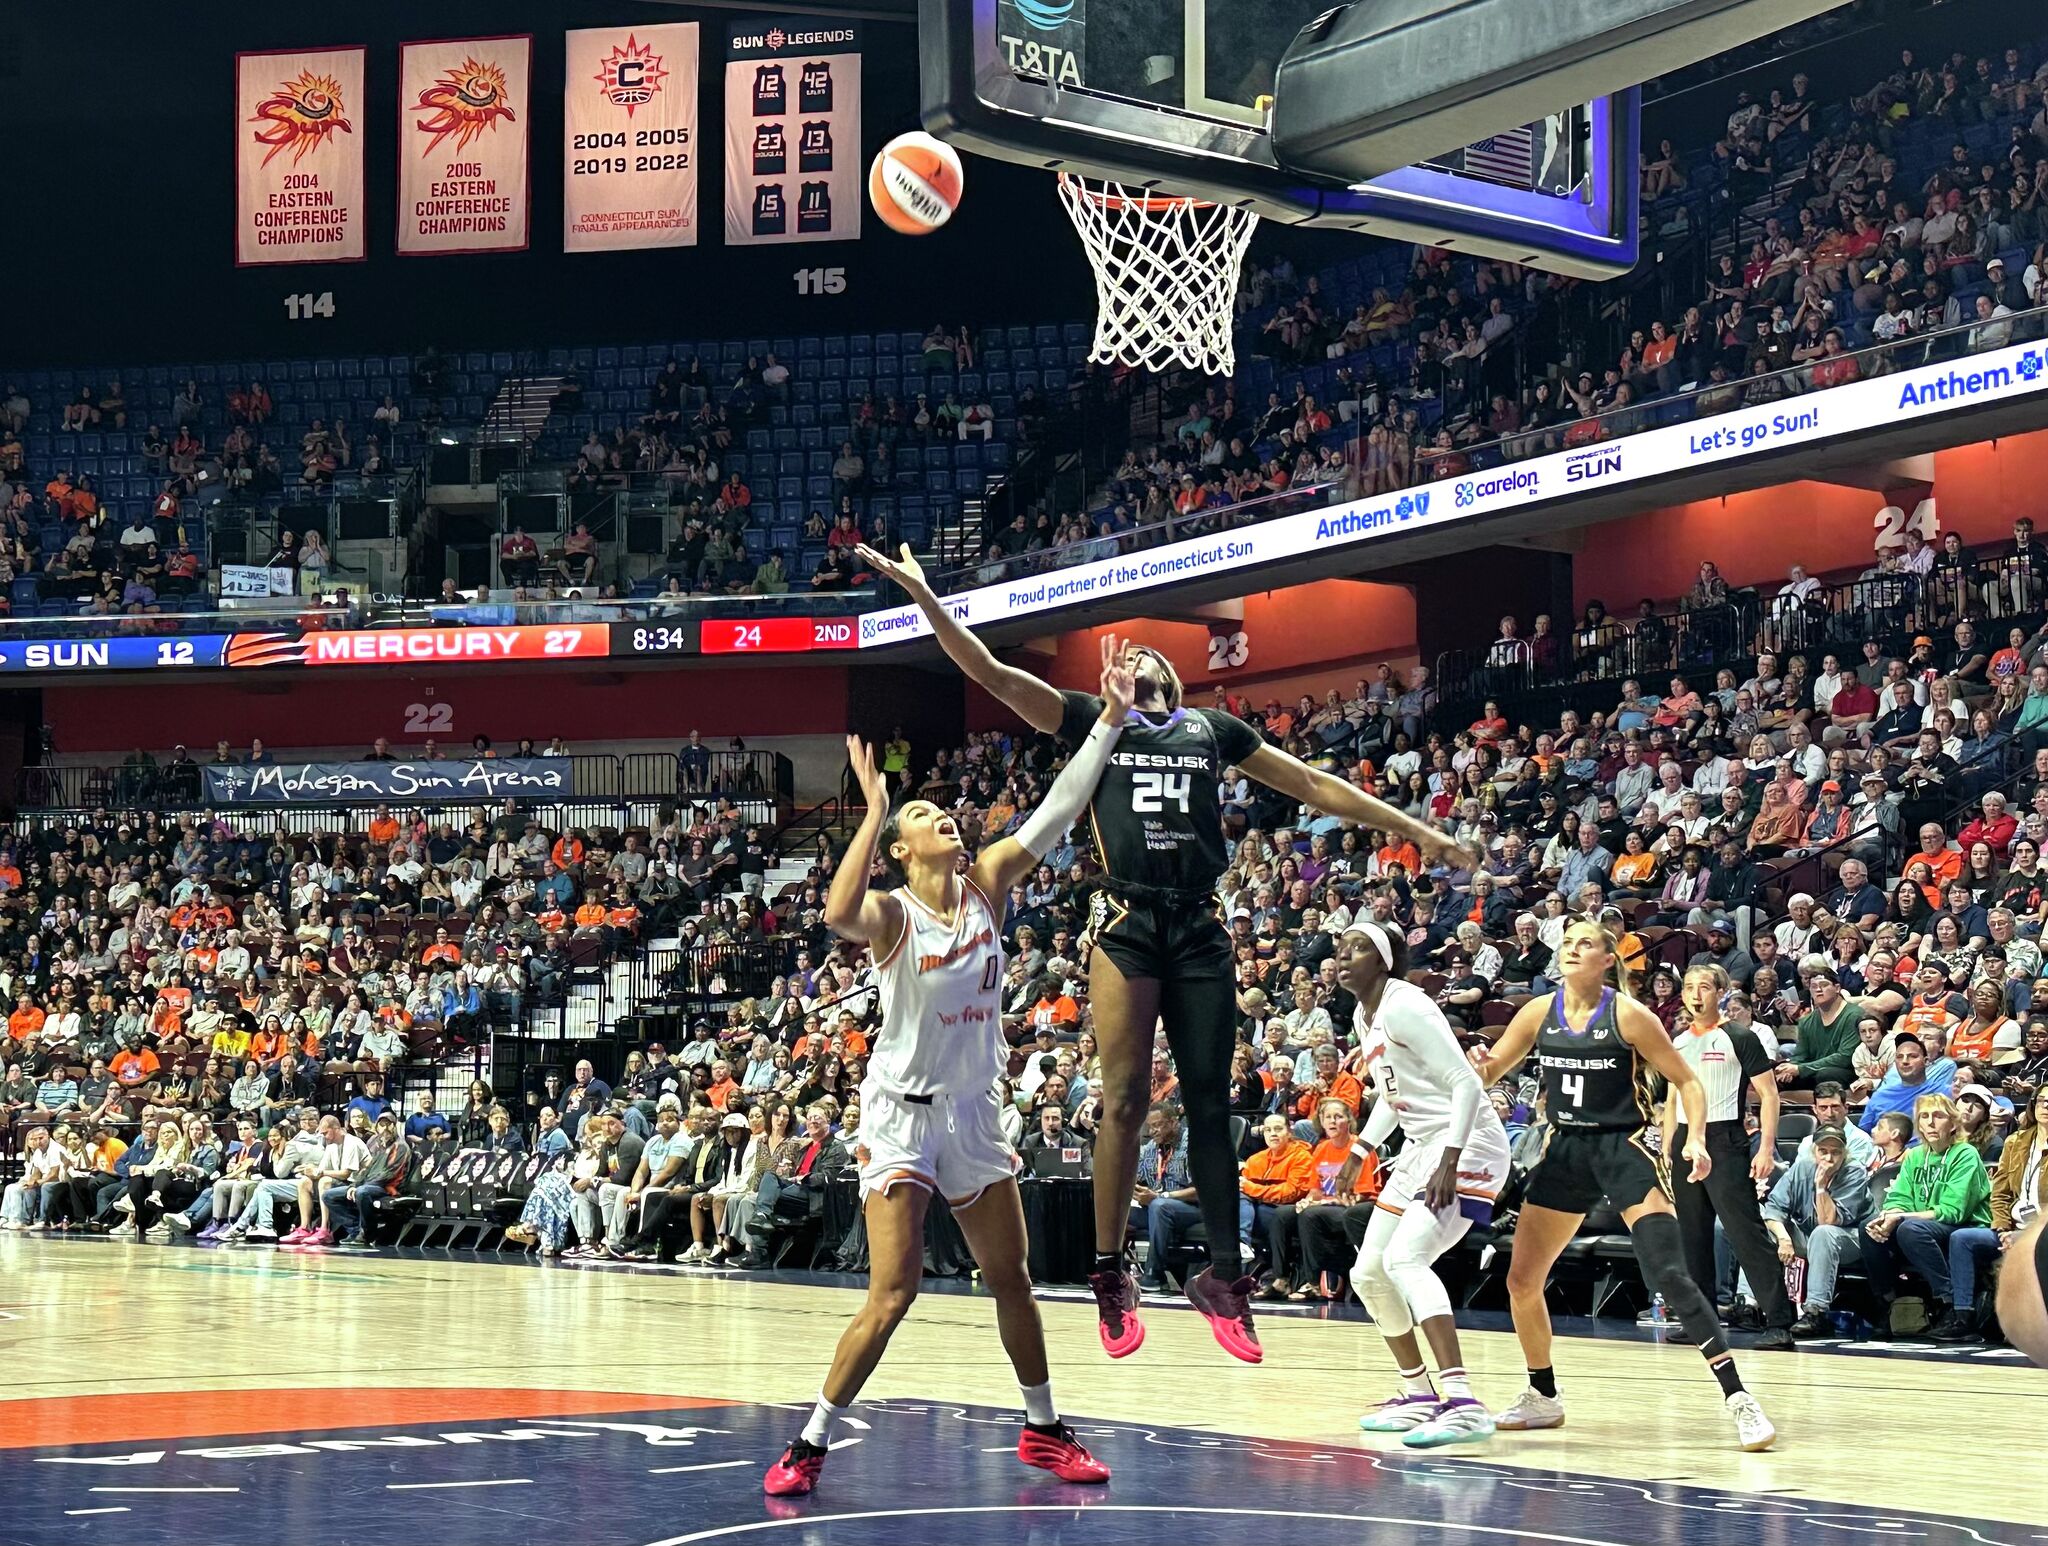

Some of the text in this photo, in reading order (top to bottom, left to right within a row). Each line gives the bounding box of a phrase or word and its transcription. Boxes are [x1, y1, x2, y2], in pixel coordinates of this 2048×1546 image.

[733, 36, 763, 49] SUN
[788, 30, 854, 45] LEGENDS
[760, 74, 779, 92] 12
[804, 72, 827, 88] 42
[574, 128, 689, 149] 2004 2005
[758, 133, 781, 150] 23
[807, 130, 825, 147] 13
[446, 163, 482, 178] 2005
[574, 154, 689, 175] 2019 2022
[283, 174, 319, 189] 2004
[431, 180, 496, 197] EASTERN
[269, 191, 333, 208] EASTERN
[415, 197, 510, 217] CONFERENCE
[761, 194, 778, 211] 15
[809, 191, 820, 209] 11
[254, 208, 347, 227] CONFERENCE
[419, 216, 506, 235] CHAMPIONS
[572, 220, 609, 233] FINALS
[581, 209, 681, 223] CONNECTICUT SUN
[258, 227, 344, 245] CHAMPIONS
[793, 267, 847, 295] 115
[284, 291, 336, 320] 114
[1898, 367, 2010, 409] Anthem
[1690, 408, 1819, 454] Let's go Sun!
[1566, 455, 1622, 482] SUN
[1476, 470, 1539, 497] carelon
[1316, 506, 1392, 540] Anthem
[1873, 498, 1941, 551] 24
[1009, 542, 1253, 608] Proud partner of the Connecticut Sun
[877, 612, 919, 632] carelon
[633, 627, 685, 651] 8:34
[734, 626, 762, 648] 24
[814, 624, 850, 643] 2ND
[25, 641, 194, 668] SUN 12
[318, 631, 582, 659] MERCURY 27
[1207, 631, 1249, 672] 23
[404, 703, 453, 733] 22
[250, 761, 562, 800] Mohegan Sun Arena
[1131, 772, 1192, 814] 24
[1380, 1065, 1398, 1096] 2
[1561, 1073, 1585, 1108] 4
